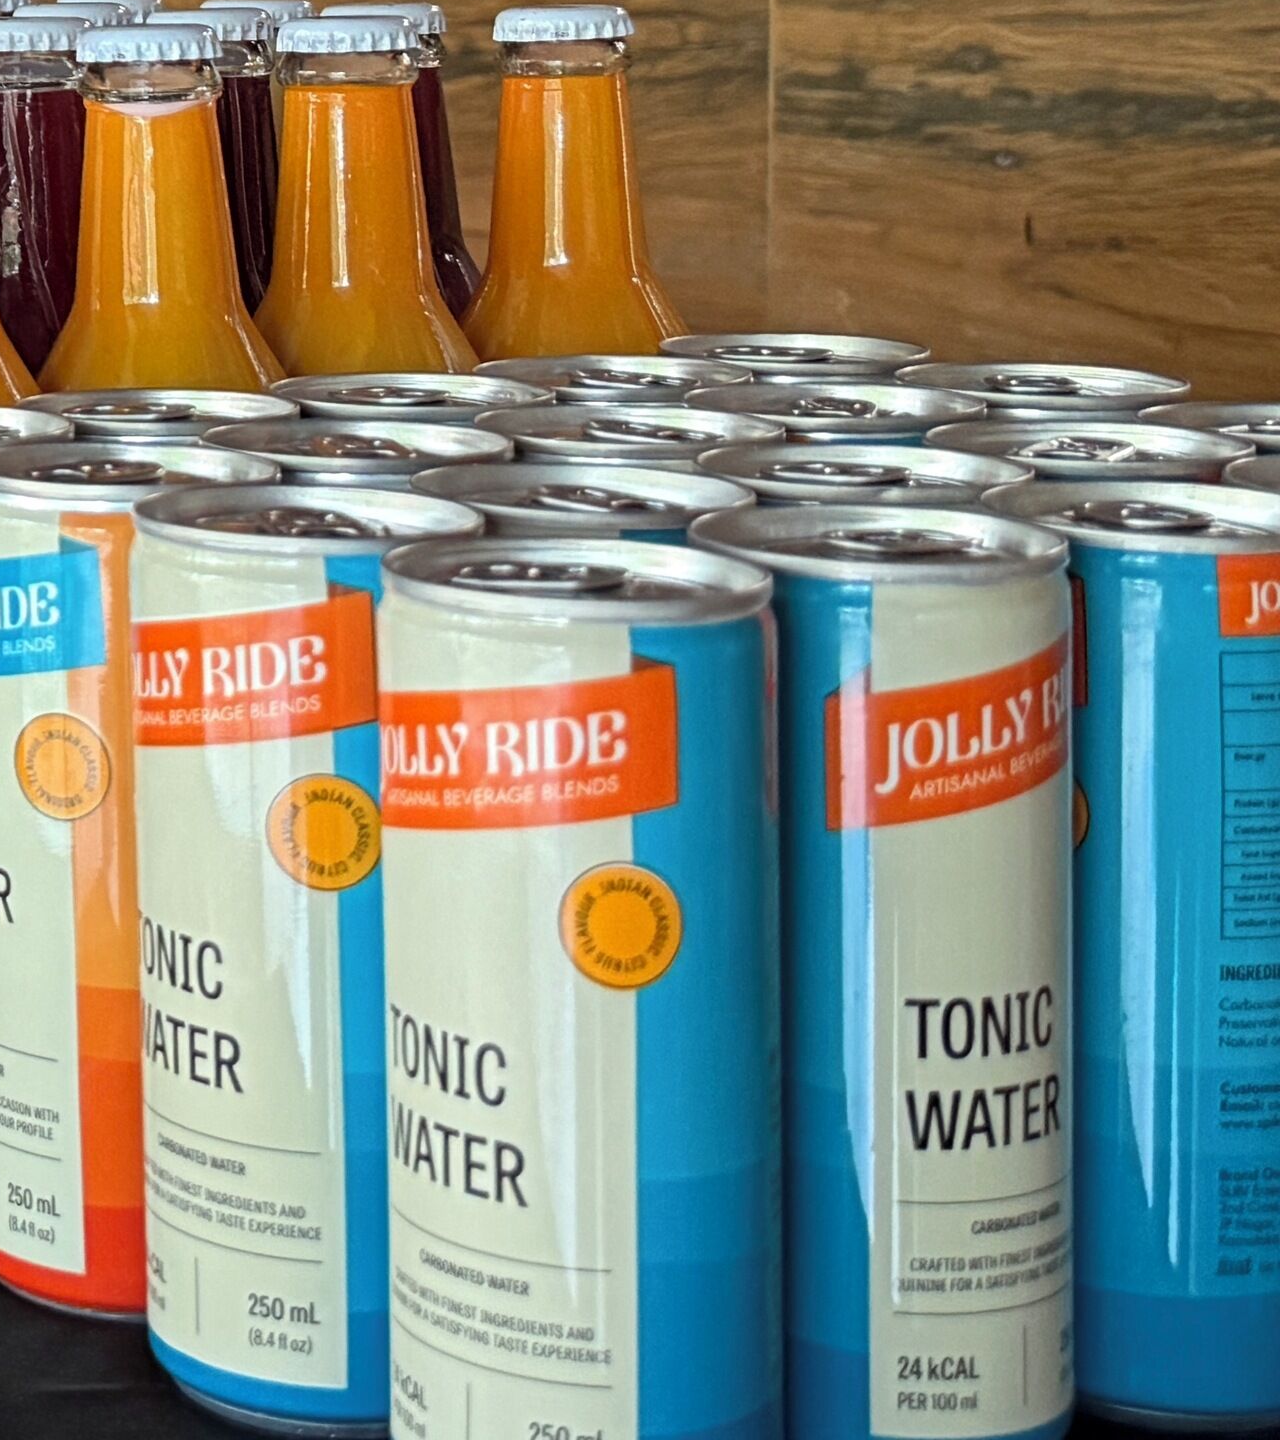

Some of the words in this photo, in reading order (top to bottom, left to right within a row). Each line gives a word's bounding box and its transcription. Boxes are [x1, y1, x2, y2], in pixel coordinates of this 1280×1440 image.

[2, 634, 57, 656] BLENDS
[134, 647, 189, 699] LLY
[201, 634, 327, 698] RIDE
[168, 703, 244, 726] BEVERAGE
[250, 695, 321, 717] BLENDS
[382, 720, 469, 777] OLLY
[484, 710, 629, 777] RIDE
[874, 688, 1033, 795] JOLLY
[443, 784, 535, 808] BEVERAGE
[542, 774, 621, 801] BLENDS
[909, 766, 1006, 801] ARTISANAL
[304, 787, 356, 810] INDIAN
[348, 806, 371, 863] CLASSIC
[142, 916, 223, 1000] ONIC
[904, 984, 1053, 1059] TONIC
[390, 1003, 507, 1107] TONIC
[16, 1119, 54, 1140] PROFILE
[34, 1106, 60, 1124] WITH
[905, 1074, 1060, 1151] WATER
[209, 1156, 246, 1176] WATER
[391, 1094, 529, 1208] WATER
[7, 1182, 34, 1210] 250
[37, 1195, 62, 1217] mL
[204, 1187, 278, 1218] INGREDIENTS
[279, 1204, 307, 1220] AND
[9, 1215, 28, 1235] (8.4
[38, 1226, 56, 1244] oz)
[215, 1208, 247, 1231] TASTE
[248, 1218, 322, 1241] EXPERIENCE
[419, 1248, 485, 1286] CARBONATED
[487, 1274, 530, 1296] WATER
[910, 1257, 965, 1272] CRAFTED
[968, 1254, 998, 1271] WITH
[950, 1276, 973, 1293] FOR
[975, 1277, 983, 1290] A
[247, 1293, 284, 1321] 250
[290, 1301, 322, 1325] mL
[441, 1296, 477, 1320] FINEST
[480, 1310, 565, 1339] INGREDIENTS
[566, 1327, 595, 1342] AND
[249, 1327, 276, 1349] (8.4
[278, 1329, 288, 1350] fl
[290, 1336, 313, 1355] oz)
[430, 1311, 490, 1347] SATISFYING
[493, 1333, 528, 1355] TASTE
[531, 1343, 612, 1365] EXPERIENCE
[898, 1356, 923, 1380] 24
[928, 1356, 980, 1381] kCAL
[897, 1392, 927, 1411] PER
[932, 1392, 958, 1411] 100
[960, 1392, 978, 1410] ml
